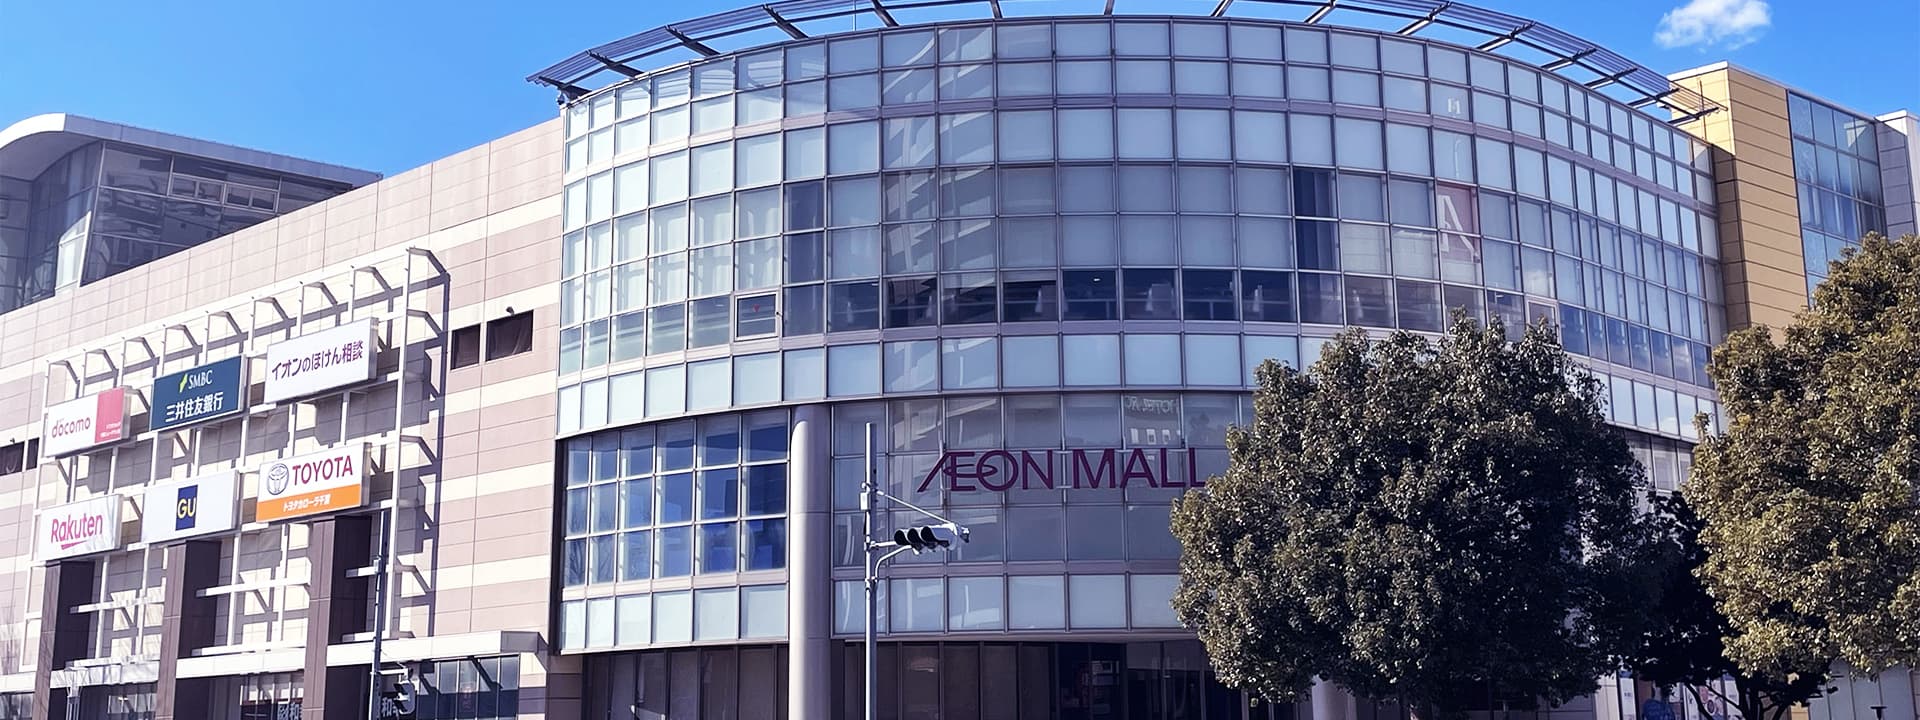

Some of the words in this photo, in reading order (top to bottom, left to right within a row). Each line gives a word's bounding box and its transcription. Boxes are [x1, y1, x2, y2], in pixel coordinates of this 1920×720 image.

[271, 340, 363, 380] イオンのほけん相談
[188, 369, 213, 389] SMBC
[165, 392, 224, 423] 三井住友銀行
[52, 417, 91, 438] docomo
[292, 455, 353, 486] TOYOTA
[1071, 447, 1207, 489] MALL
[177, 498, 196, 519] GU
[50, 512, 103, 544] Rakuten
